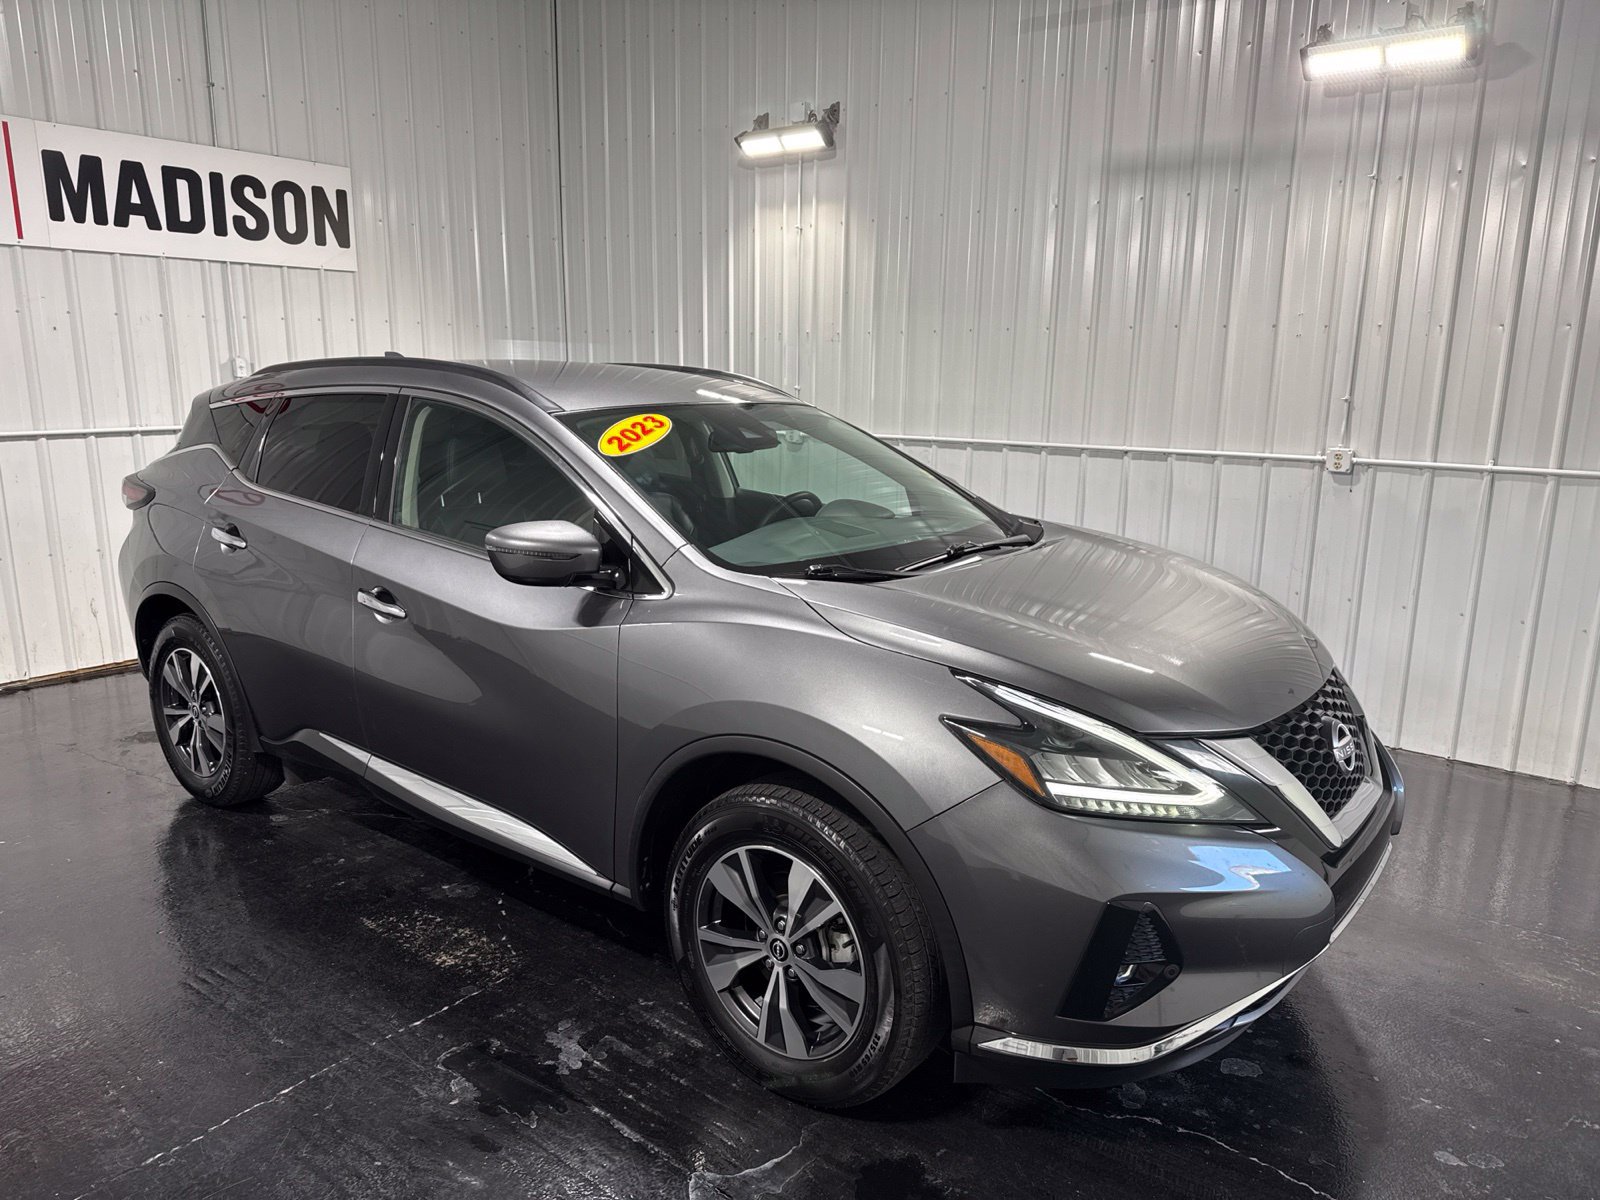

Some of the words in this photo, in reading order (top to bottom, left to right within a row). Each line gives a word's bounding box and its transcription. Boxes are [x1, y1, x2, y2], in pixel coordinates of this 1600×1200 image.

[41, 149, 351, 249] MADISON
[607, 416, 665, 452] 2023
[1333, 742, 1354, 761] NISS
